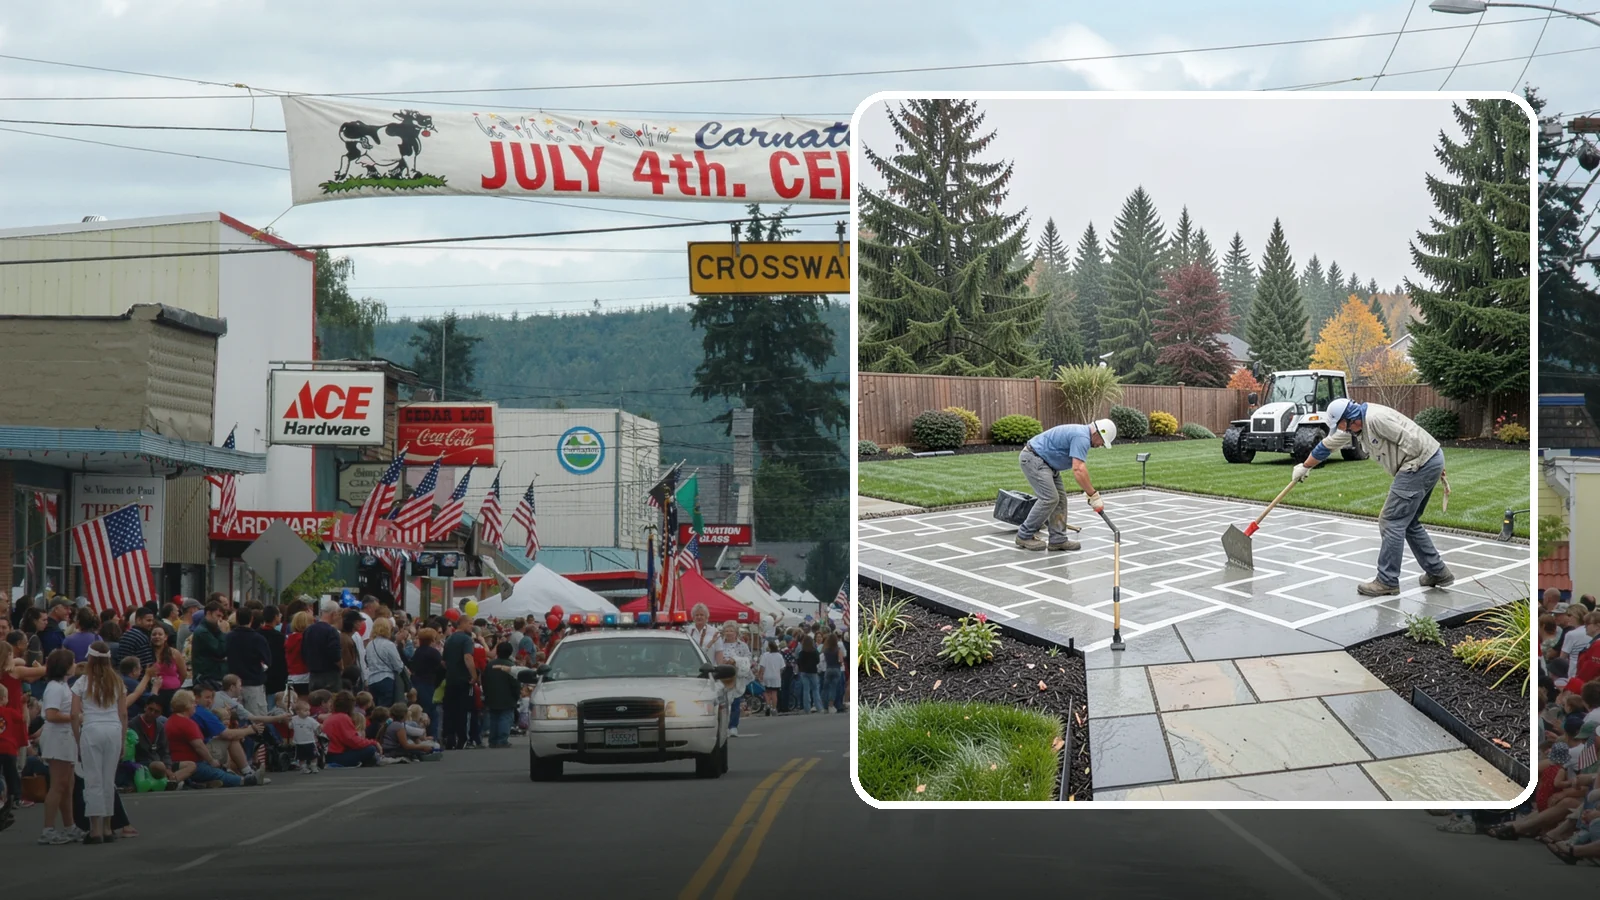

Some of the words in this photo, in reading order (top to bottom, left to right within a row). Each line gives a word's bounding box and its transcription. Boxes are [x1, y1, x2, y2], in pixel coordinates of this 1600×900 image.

[481, 140, 605, 193] JULY
[632, 150, 747, 198] 4th.
[697, 254, 850, 280] CROSSWA
[283, 380, 373, 419] ACE
[406, 409, 453, 421] CEDAR
[461, 409, 485, 421] LOG
[283, 421, 370, 436] Hardware
[416, 428, 476, 446] Coca-Cola
[95, 485, 124, 494] Vincent
[126, 486, 136, 494] de
[137, 486, 155, 495] Paul
[688, 526, 741, 535] CRNATION
[699, 535, 730, 543] GLASS
